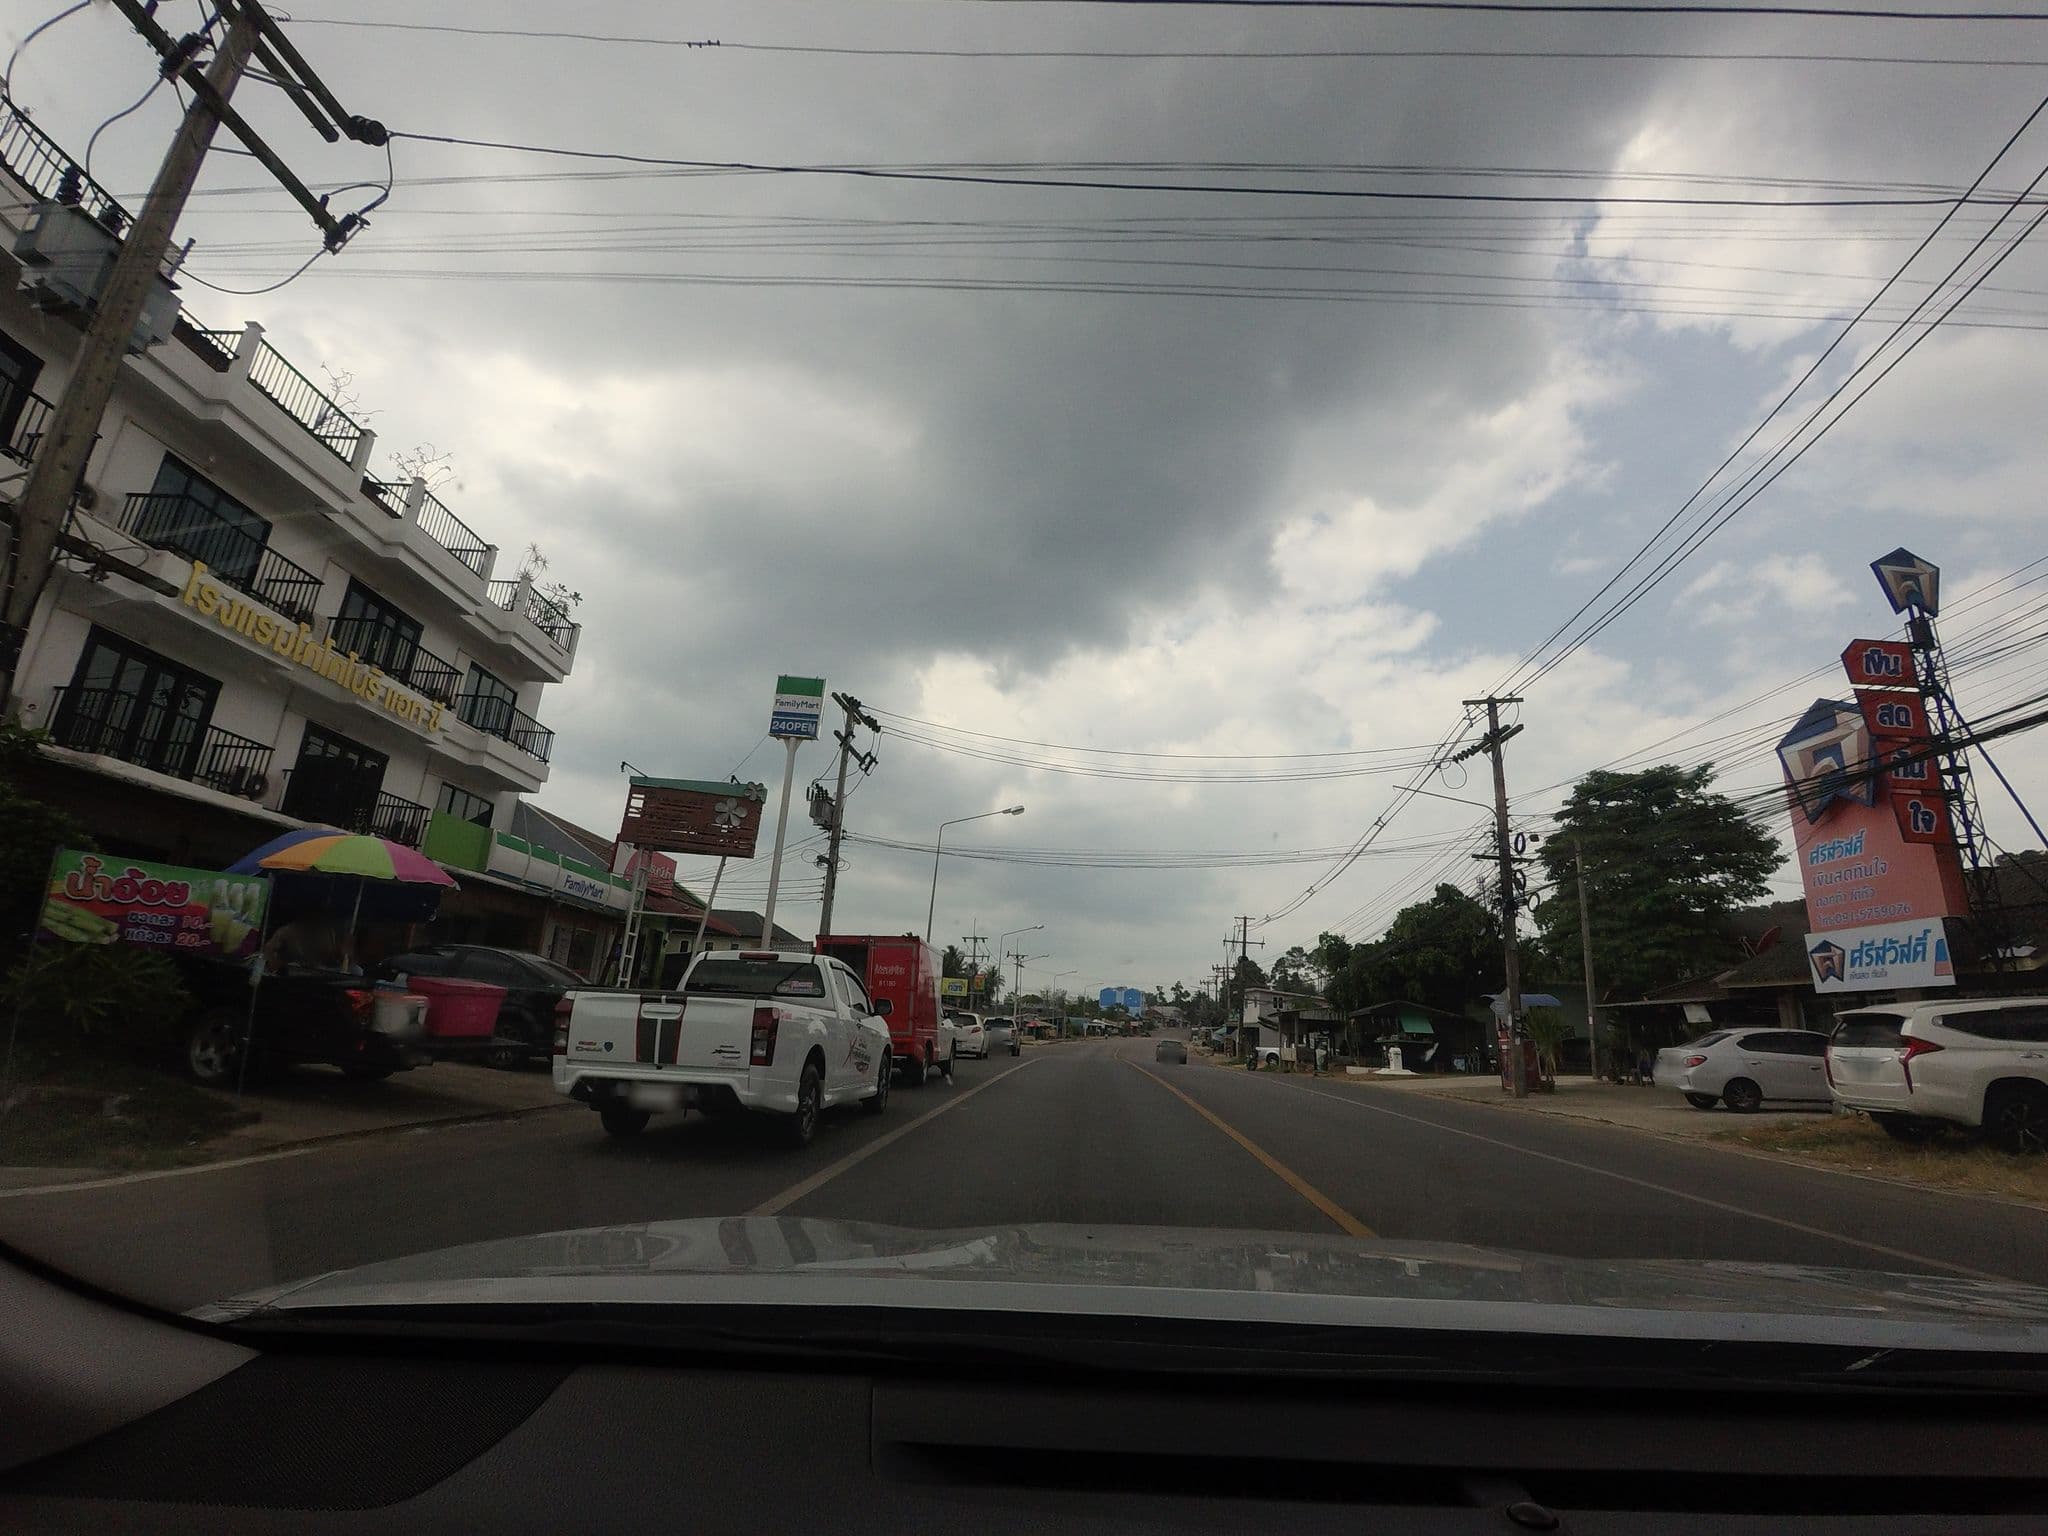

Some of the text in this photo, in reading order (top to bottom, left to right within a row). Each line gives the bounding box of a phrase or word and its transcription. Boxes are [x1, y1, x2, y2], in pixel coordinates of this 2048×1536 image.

[1864, 647, 1902, 677] เงิน
[775, 698, 819, 710] FamilyMart
[1876, 701, 1913, 728] สด
[1908, 800, 1936, 833] ใจ
[65, 855, 192, 907] น้ำอ้อย
[563, 874, 604, 899] FamilyMart
